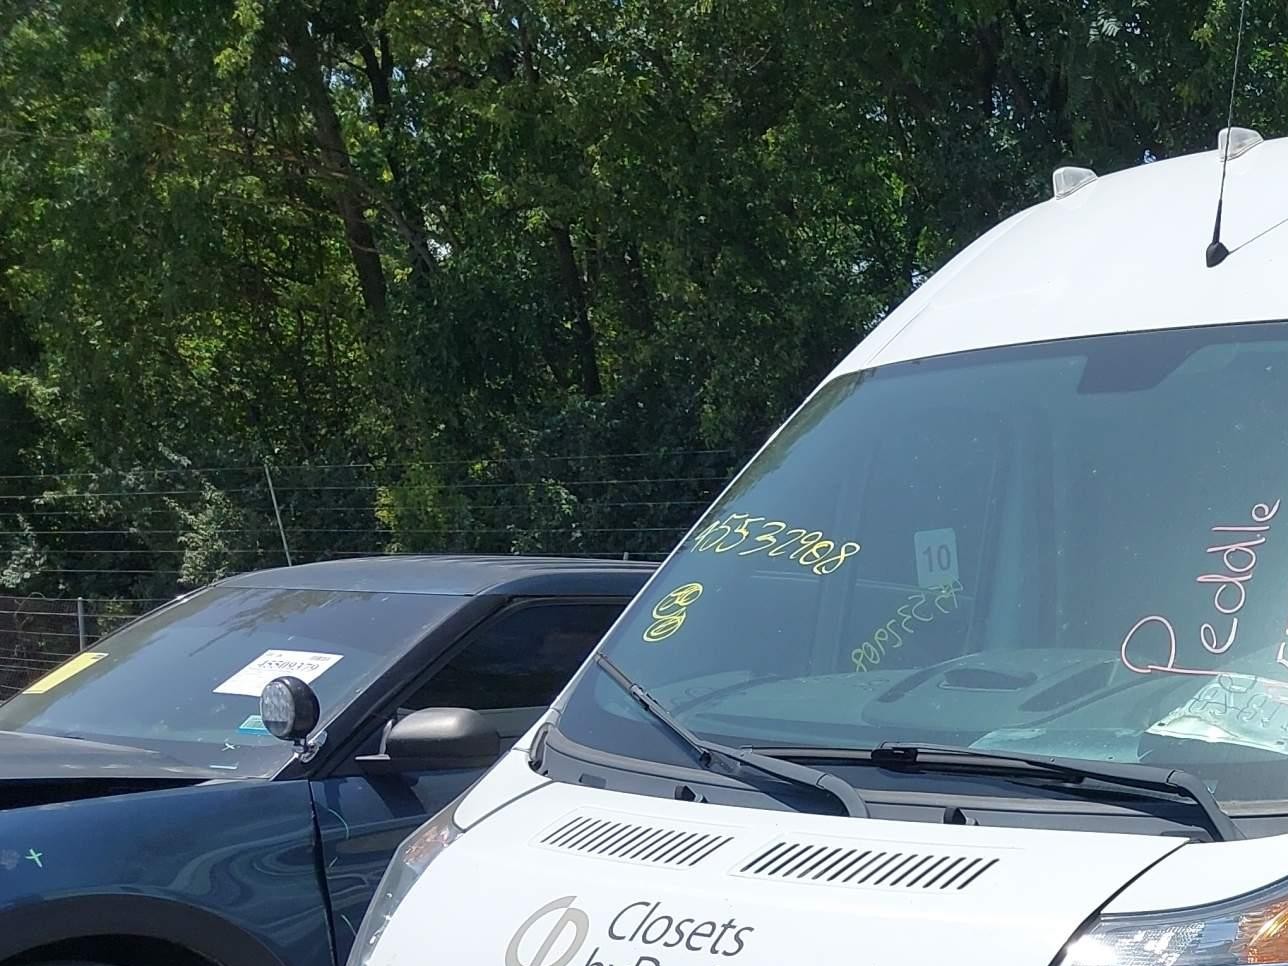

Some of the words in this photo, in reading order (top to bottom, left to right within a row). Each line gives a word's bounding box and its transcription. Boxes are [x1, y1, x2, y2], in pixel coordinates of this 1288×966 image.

[922, 544, 952, 574] 10
[1121, 498, 1281, 678] Peddle
[608, 900, 756, 957] Closets
